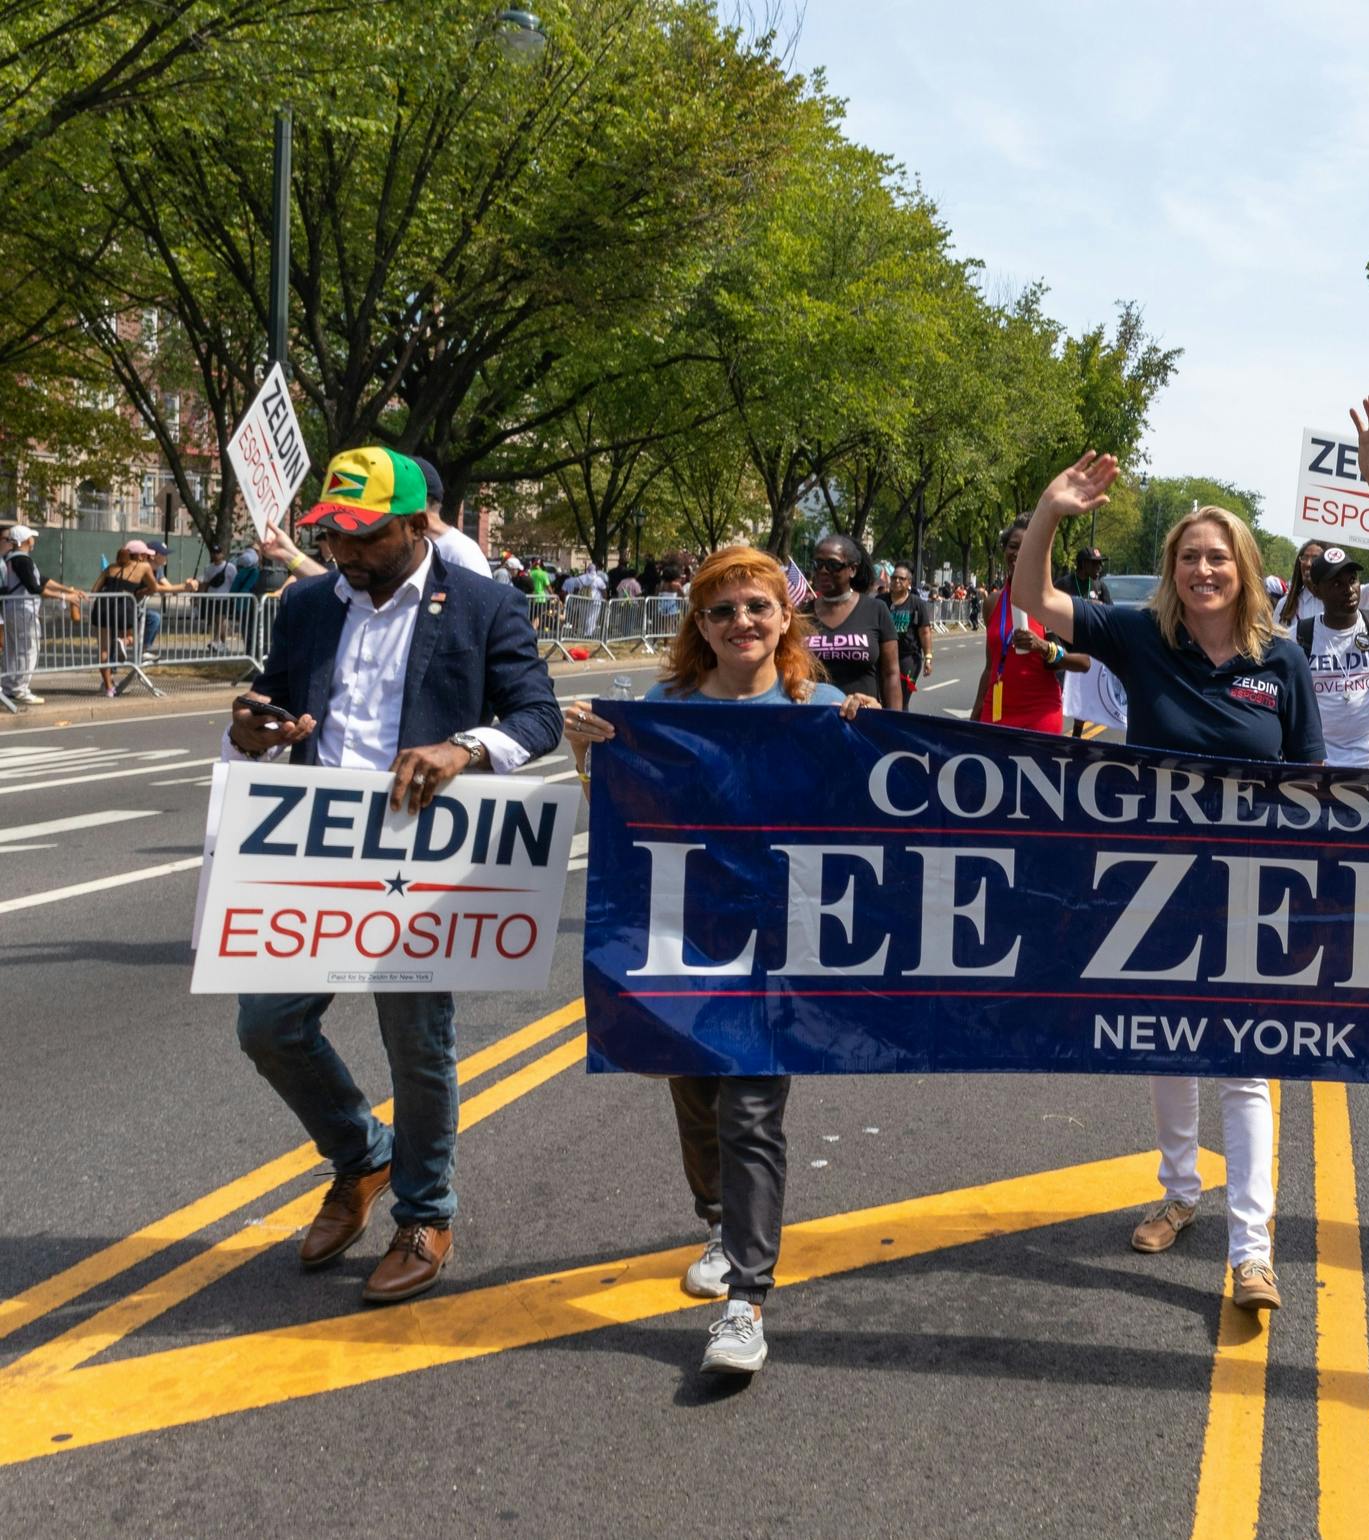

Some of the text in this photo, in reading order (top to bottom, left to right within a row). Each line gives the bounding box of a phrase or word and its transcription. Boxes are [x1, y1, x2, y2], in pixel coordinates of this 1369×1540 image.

[262, 378, 305, 489] ZELDIN
[238, 423, 280, 523] ESPOSITO
[812, 650, 870, 661] VERNOR
[1232, 675, 1278, 696] ZELDIN
[239, 783, 558, 867] ZELDIN
[218, 907, 538, 959] ESPOSITO
[625, 841, 1021, 978] LEE
[1094, 1013, 1356, 1059] NEW YORK
